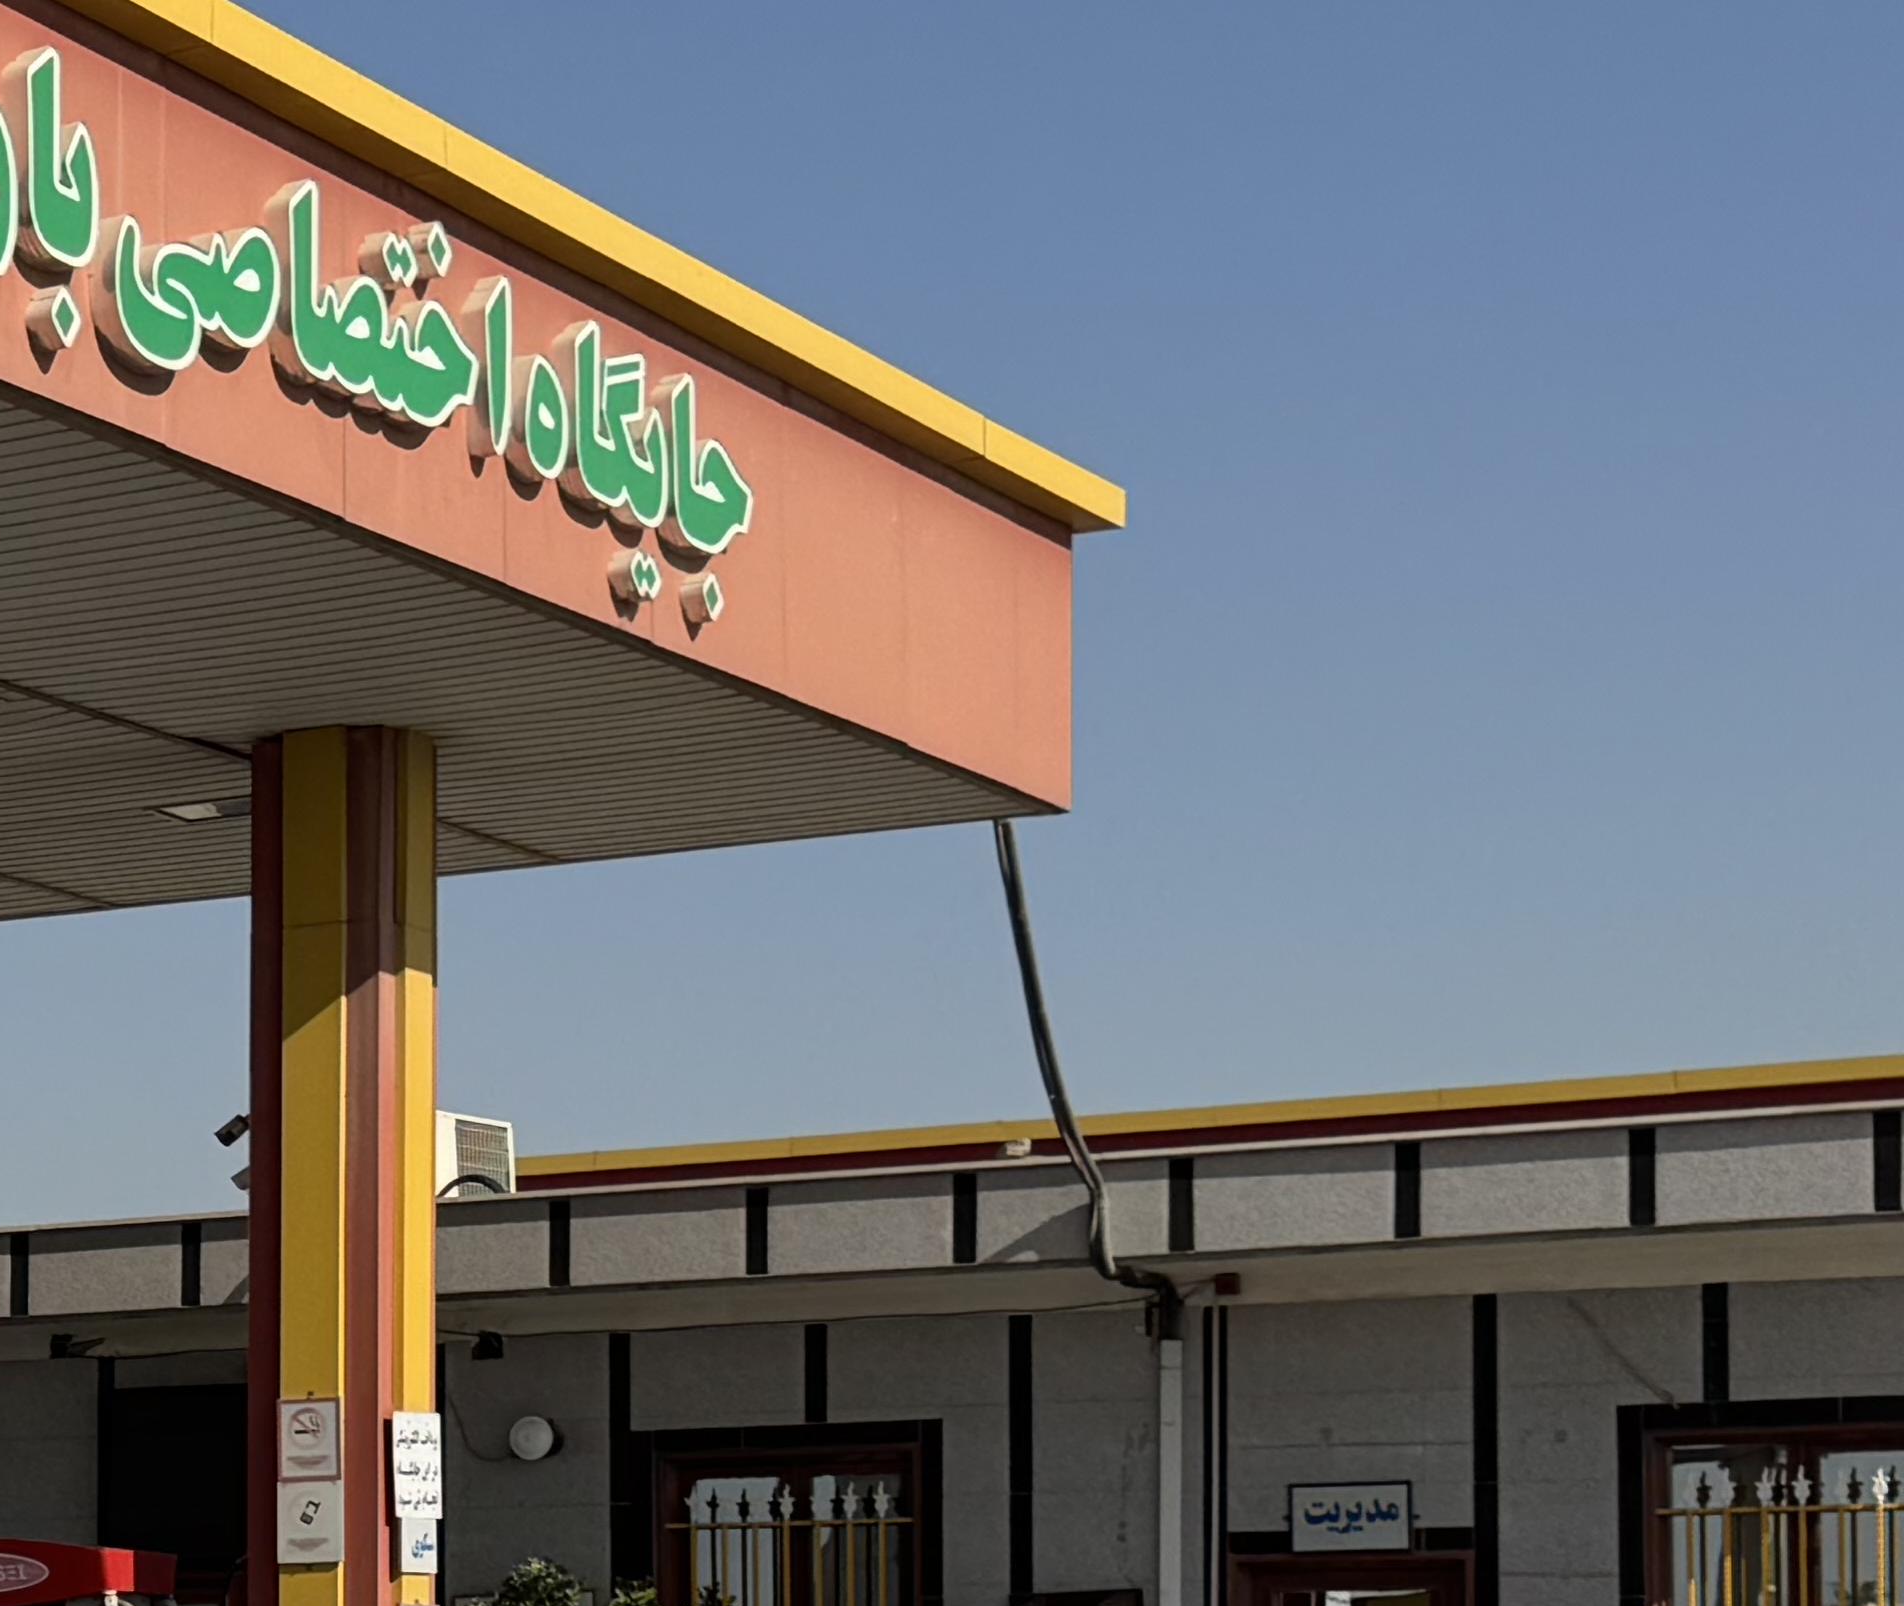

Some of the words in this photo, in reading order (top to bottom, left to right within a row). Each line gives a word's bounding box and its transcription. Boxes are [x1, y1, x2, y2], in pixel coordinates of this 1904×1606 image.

[114, 179, 510, 456] اختصاصی
[524, 319, 753, 622] جایگاه
[1303, 1498, 1399, 1535] مدیریت
